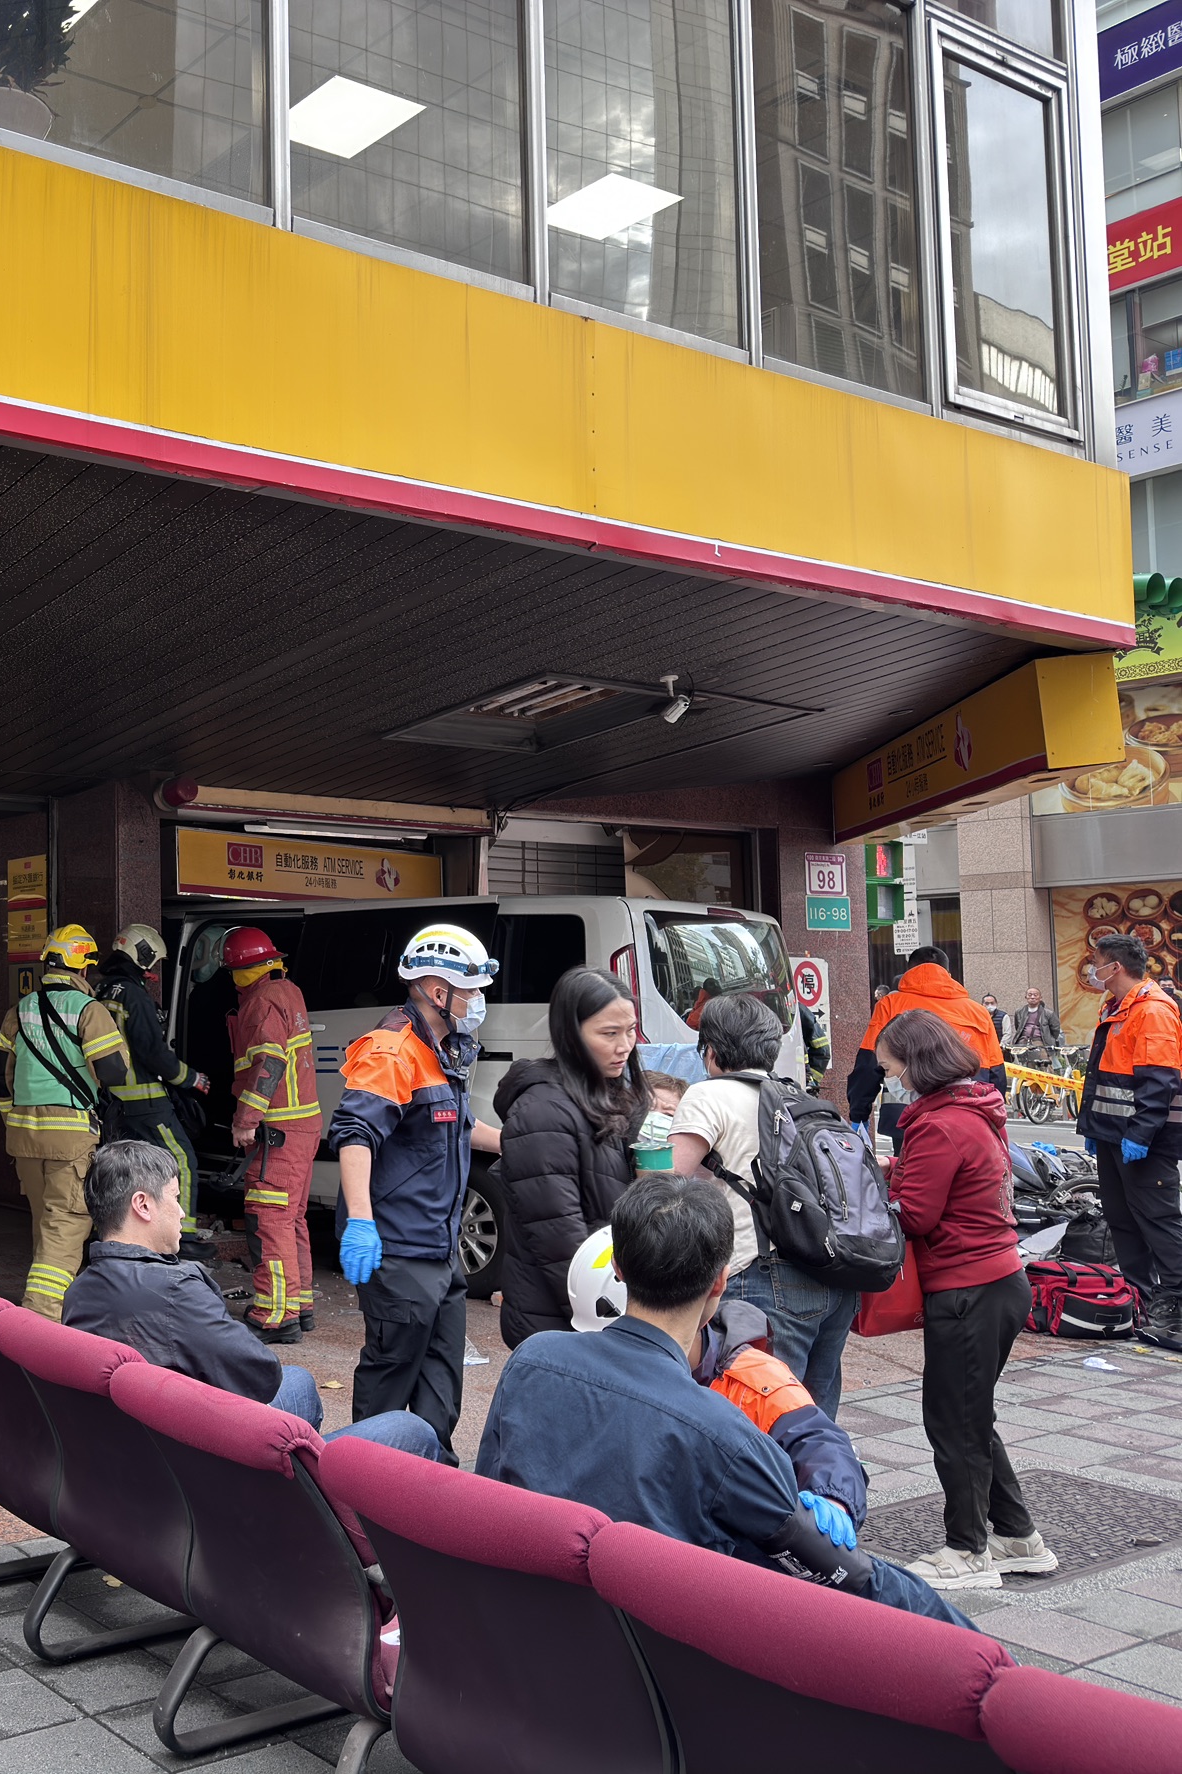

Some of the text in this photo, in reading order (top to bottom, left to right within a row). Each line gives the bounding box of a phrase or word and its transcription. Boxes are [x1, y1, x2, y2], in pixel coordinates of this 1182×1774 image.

[1117, 439, 1173, 462] SENSE
[229, 845, 262, 865] CHB
[275, 852, 364, 876] 自動化服務 ATM SERVICE
[227, 868, 264, 883] 彰化銀行
[305, 876, 338, 890] 24小時服務
[817, 870, 836, 890] 98
[809, 907, 848, 921] 116-98
[801, 973, 815, 995] 停
